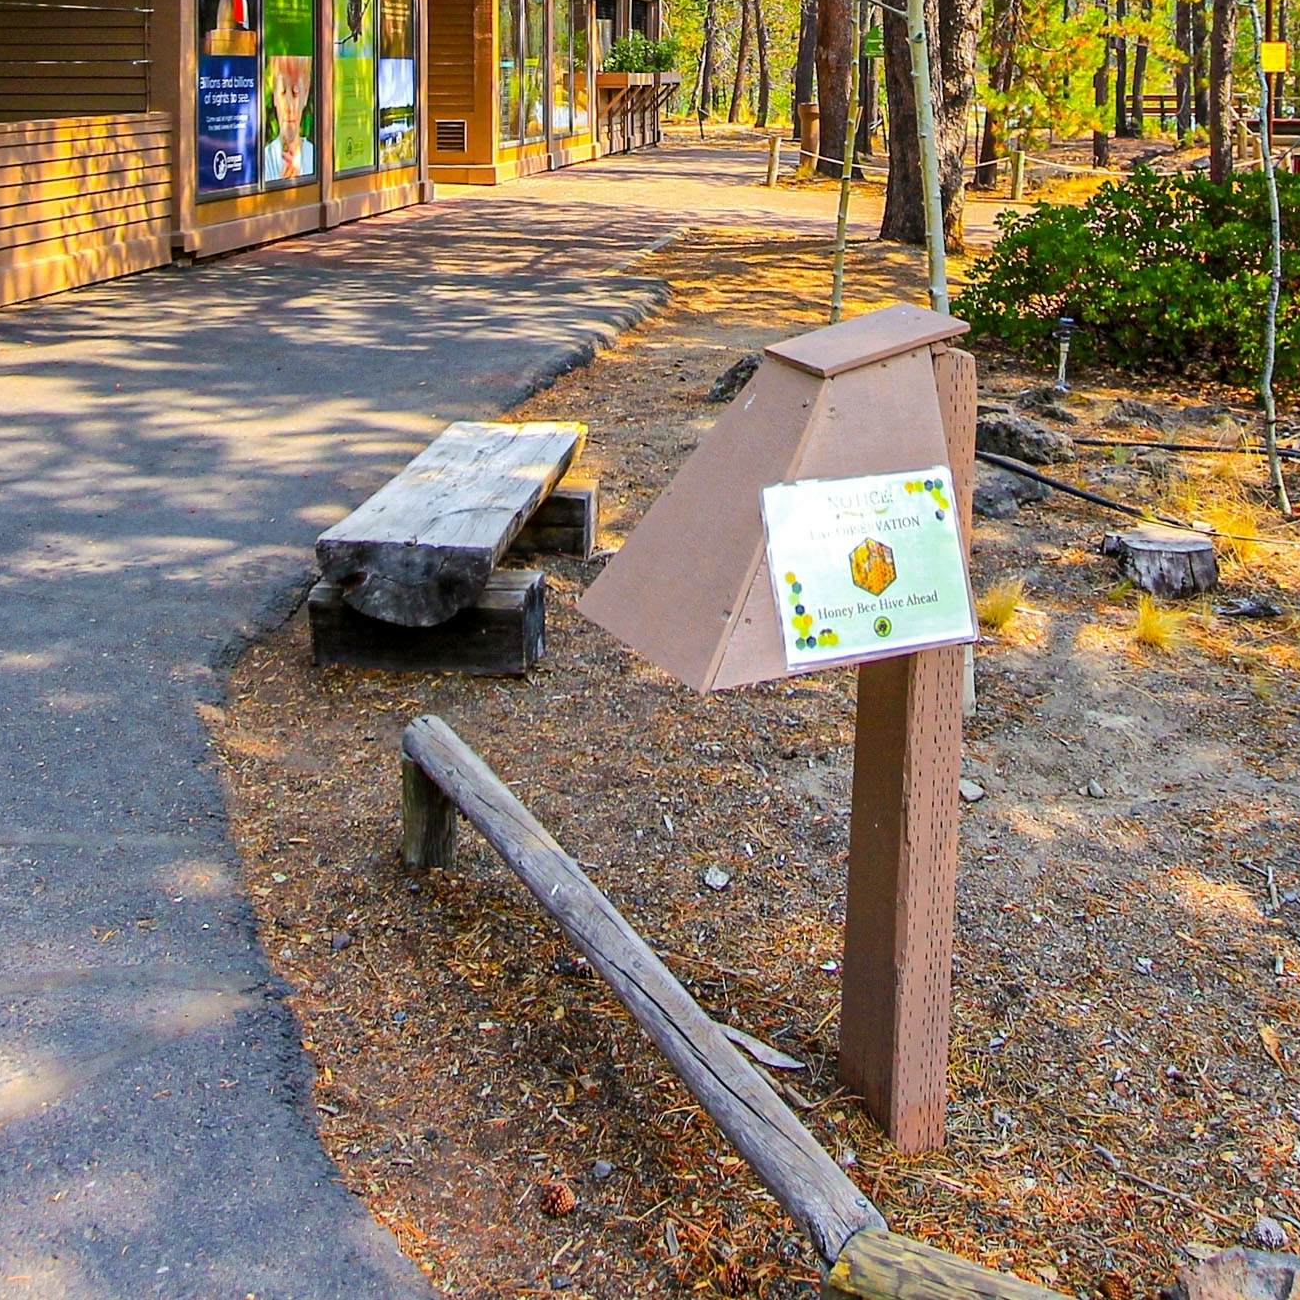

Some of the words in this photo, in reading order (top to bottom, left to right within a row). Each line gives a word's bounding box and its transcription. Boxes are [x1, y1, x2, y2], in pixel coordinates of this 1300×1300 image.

[200, 75, 221, 89] Billions
[222, 76, 233, 88] and
[234, 76, 254, 88] billions
[204, 92, 211, 104] of
[212, 92, 230, 106] sights
[230, 92, 237, 104] to
[817, 607, 854, 620] Honey
[857, 602, 877, 615] Bee
[880, 599, 904, 611] Hive
[906, 590, 939, 607] Ahead
